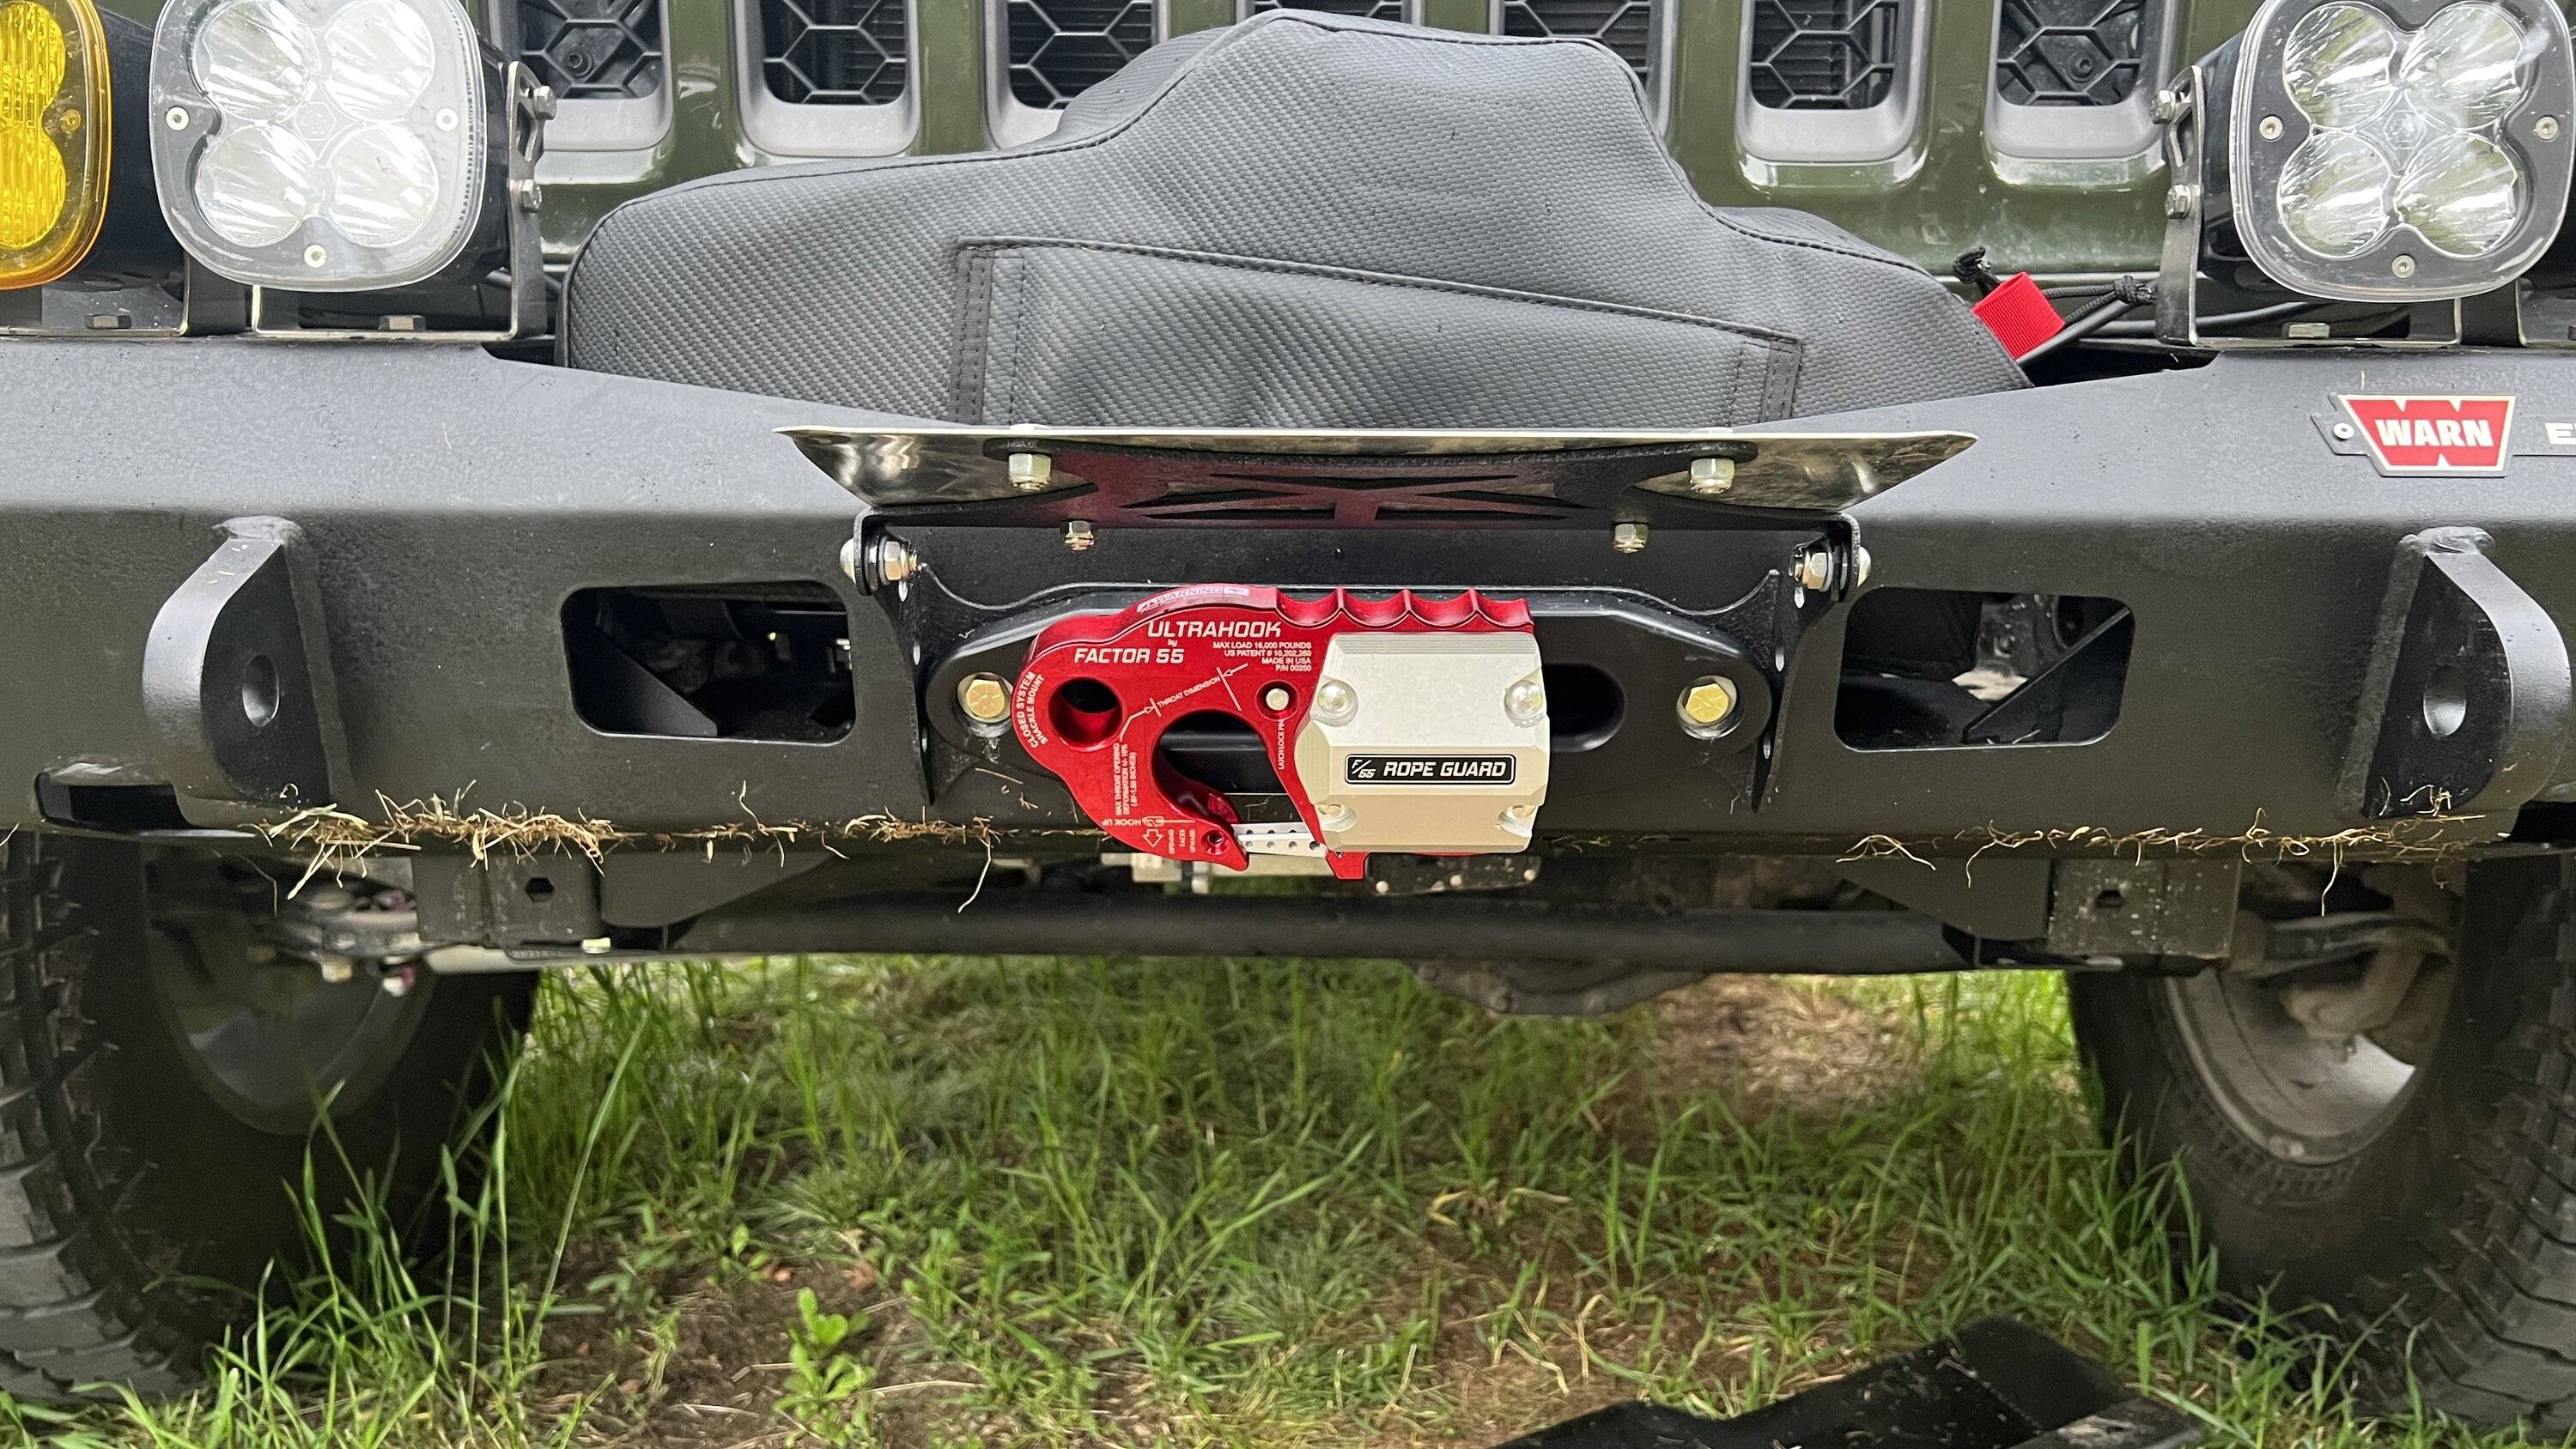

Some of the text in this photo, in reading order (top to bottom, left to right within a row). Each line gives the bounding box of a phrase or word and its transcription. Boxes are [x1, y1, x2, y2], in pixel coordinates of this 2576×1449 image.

[2373, 418, 2494, 447] WARN
[1156, 586, 1221, 603] WARNING
[1147, 621, 1282, 638] ULTRAHOOK
[1167, 638, 1178, 647] by
[1074, 647, 1185, 664] FACTOR 55
[1157, 691, 1185, 708] THROAT
[1016, 670, 1040, 749] CLOSED SYSTEM
[1025, 673, 1049, 746] SHACKLE MOUNT
[1383, 761, 1437, 777] ROPE
[1440, 761, 1507, 777] GUARD
[1101, 818, 1142, 827] HOOK UP
